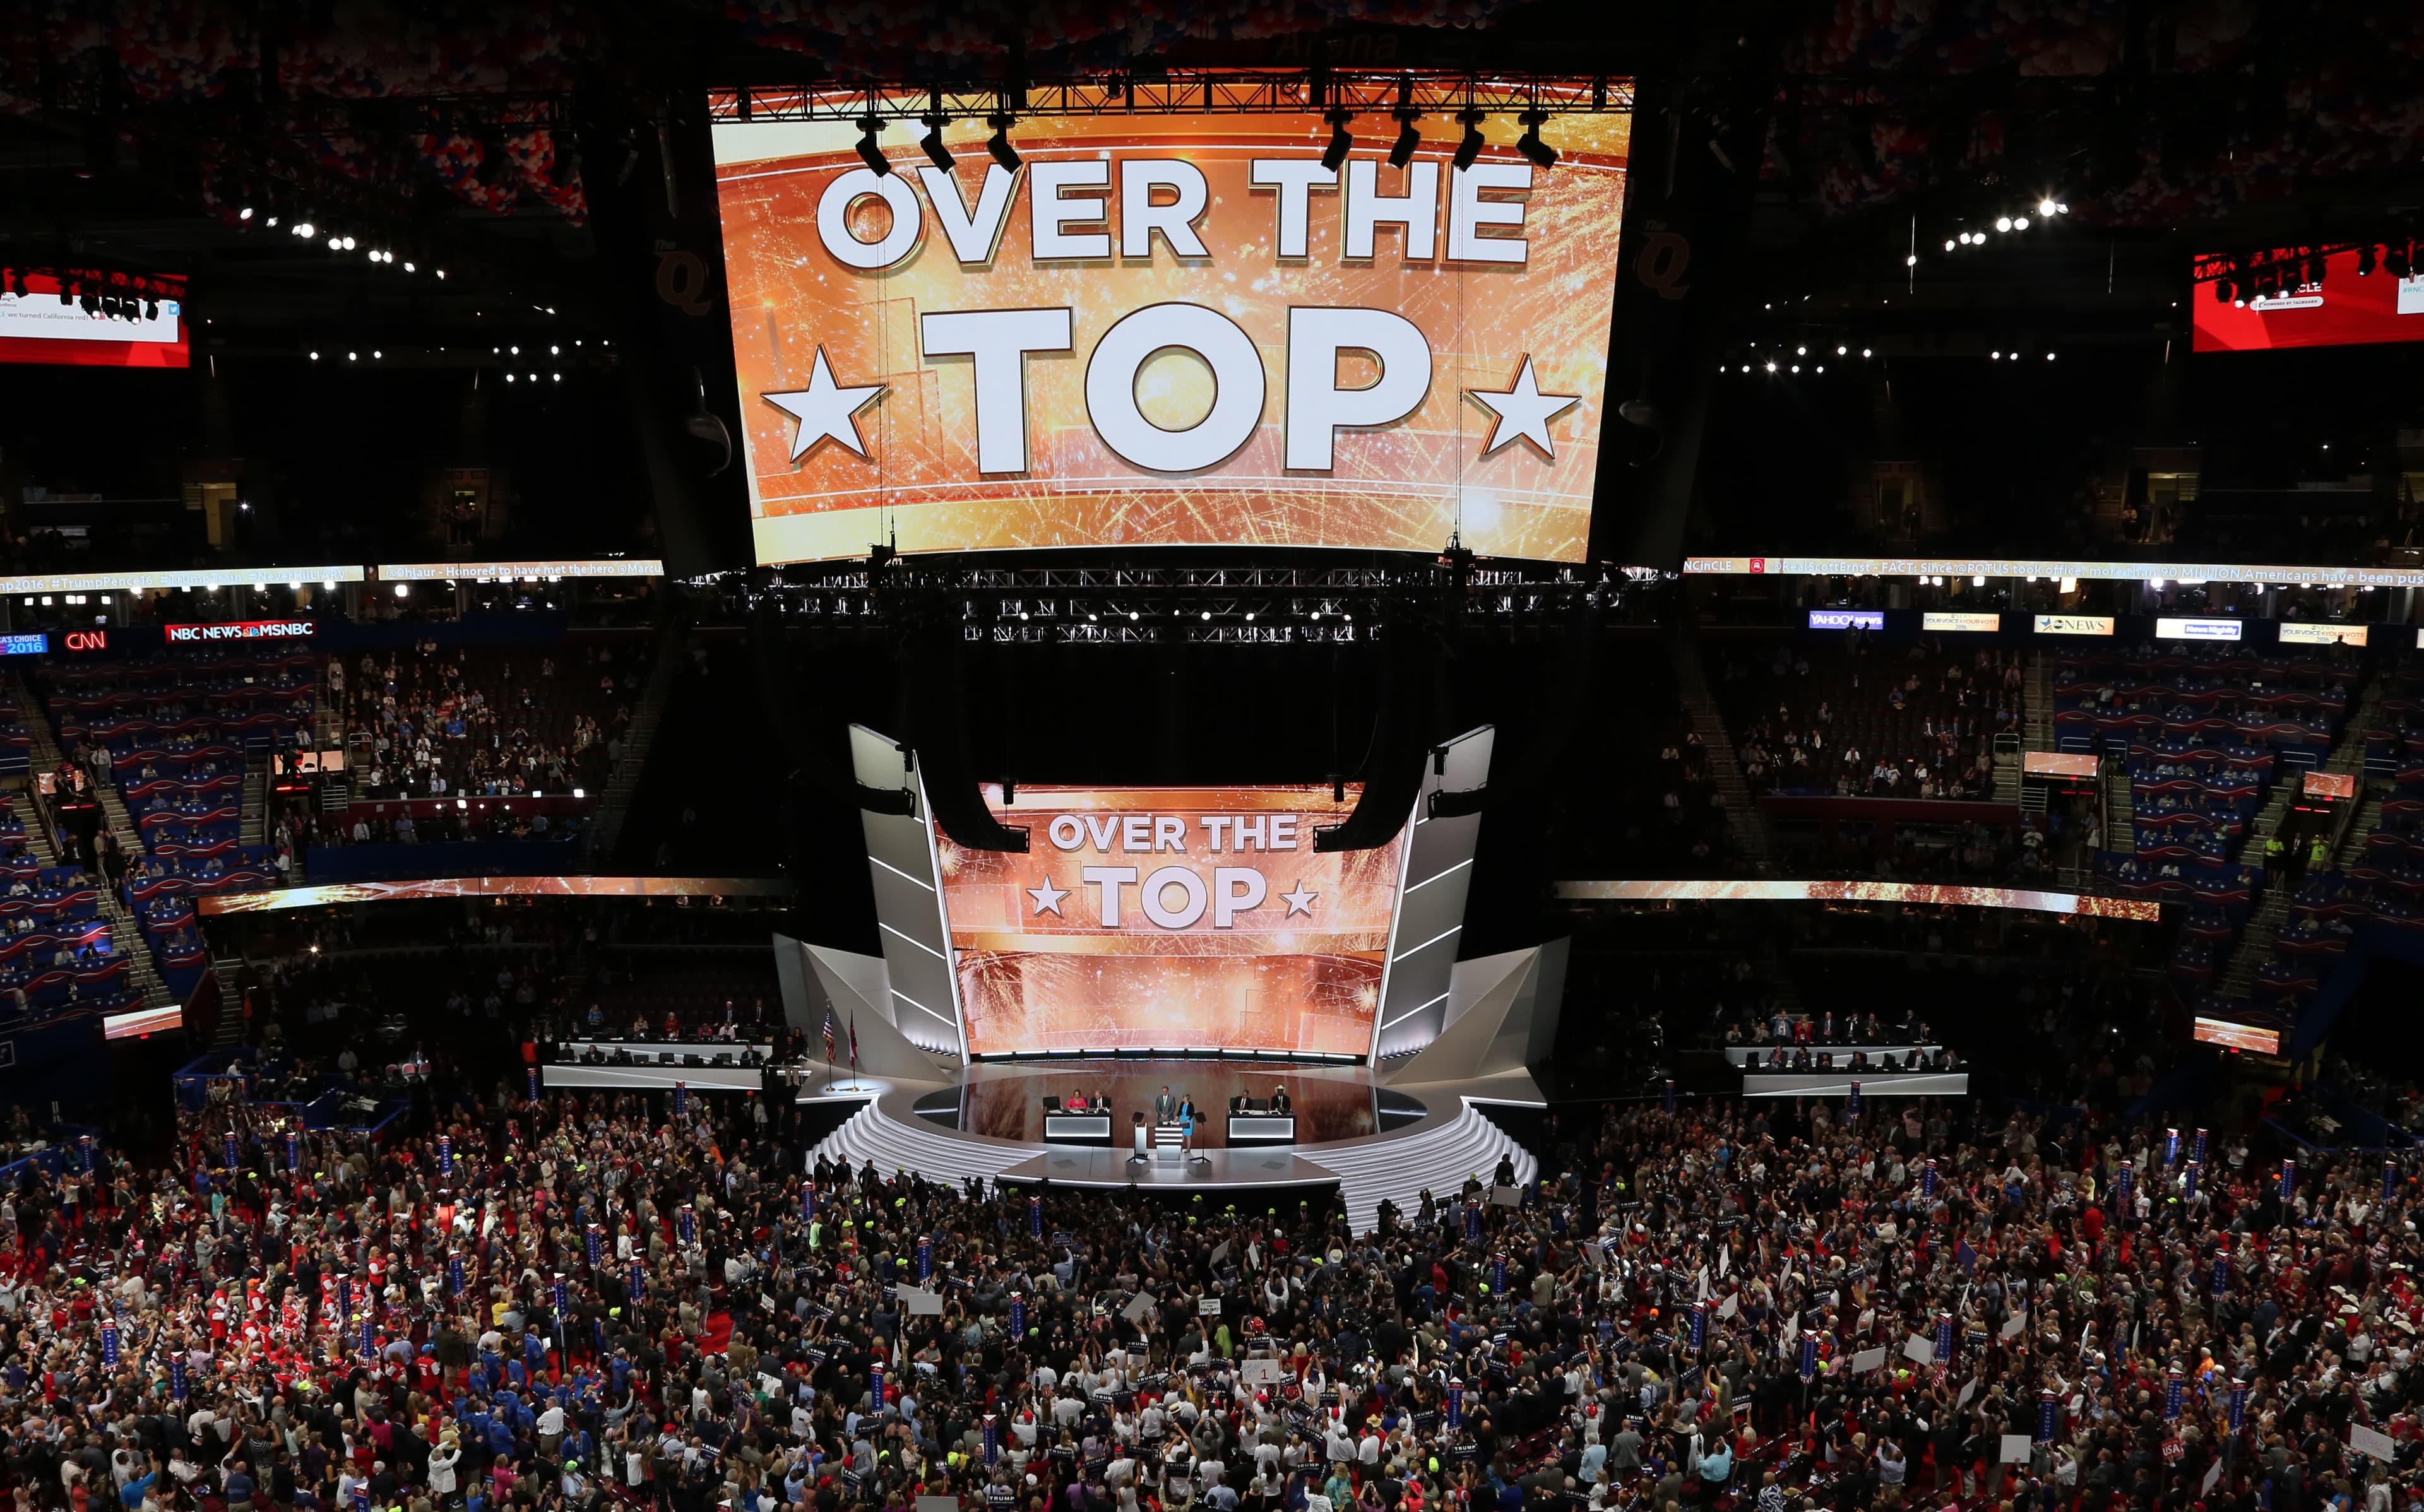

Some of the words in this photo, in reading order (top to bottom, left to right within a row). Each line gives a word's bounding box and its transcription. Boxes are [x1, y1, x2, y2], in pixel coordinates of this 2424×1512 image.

[816, 158, 1212, 268] OVER
[1249, 158, 1531, 265] THE
[922, 302, 1435, 475] TOP
[446, 565, 496, 577] Honored
[498, 565, 511, 576] to
[514, 565, 541, 575] have
[544, 565, 566, 574] met
[569, 564, 588, 574] the
[589, 563, 614, 574] hero
[1881, 562, 1917, 573] FACT:
[1920, 563, 1952, 574] Since
[1956, 564, 2009, 575] @POTUS
[2012, 564, 2040, 574] took
[2045, 565, 2084, 576] office,
[2089, 567, 2121, 576] more
[2122, 565, 2155, 577] than
[2161, 567, 2177, 577] 90
[2182, 567, 2240, 579] MILLION
[2245, 569, 2317, 582] Americans
[2320, 570, 2355, 582] have
[2358, 571, 2394, 583] been
[50, 575, 153, 589] #TrumpPence16
[160, 572, 242, 585] #TrumpTrain
[170, 627, 201, 641] NBC
[203, 625, 242, 639] NEWS
[259, 622, 314, 637] MSNBC
[2064, 620, 2106, 631] NEWS
[14, 634, 42, 642] CHOICE
[66, 630, 105, 650] CNN
[7, 642, 44, 654] 2016
[1048, 814, 1188, 852] OVER
[1199, 814, 1300, 852] THE
[1083, 866, 1268, 930] TOP
[1669, 1270, 1687, 1280] TRUMP
[816, 1304, 834, 1314] TRUMP
[1806, 1306, 1821, 1316] TRUMP
[1653, 1332, 1673, 1341] TRUMP
[1572, 1350, 1588, 1360] TRUMP
[1490, 1359, 1508, 1368] TRUMP
[1680, 1365, 1699, 1378] TRUMP
[1137, 1374, 1157, 1383] TRUMP
[1414, 1410, 1434, 1419] TRUMP
[858, 1424, 880, 1432] TRUMP
[1824, 1419, 1839, 1433] TRUMP
[1302, 1428, 1323, 1441] TRUMP
[702, 1443, 721, 1453] TRUMP
[2163, 1443, 2182, 1456] USA
[1085, 1458, 1105, 1467] TRUMP
[844, 1468, 860, 1480] TRUMP
